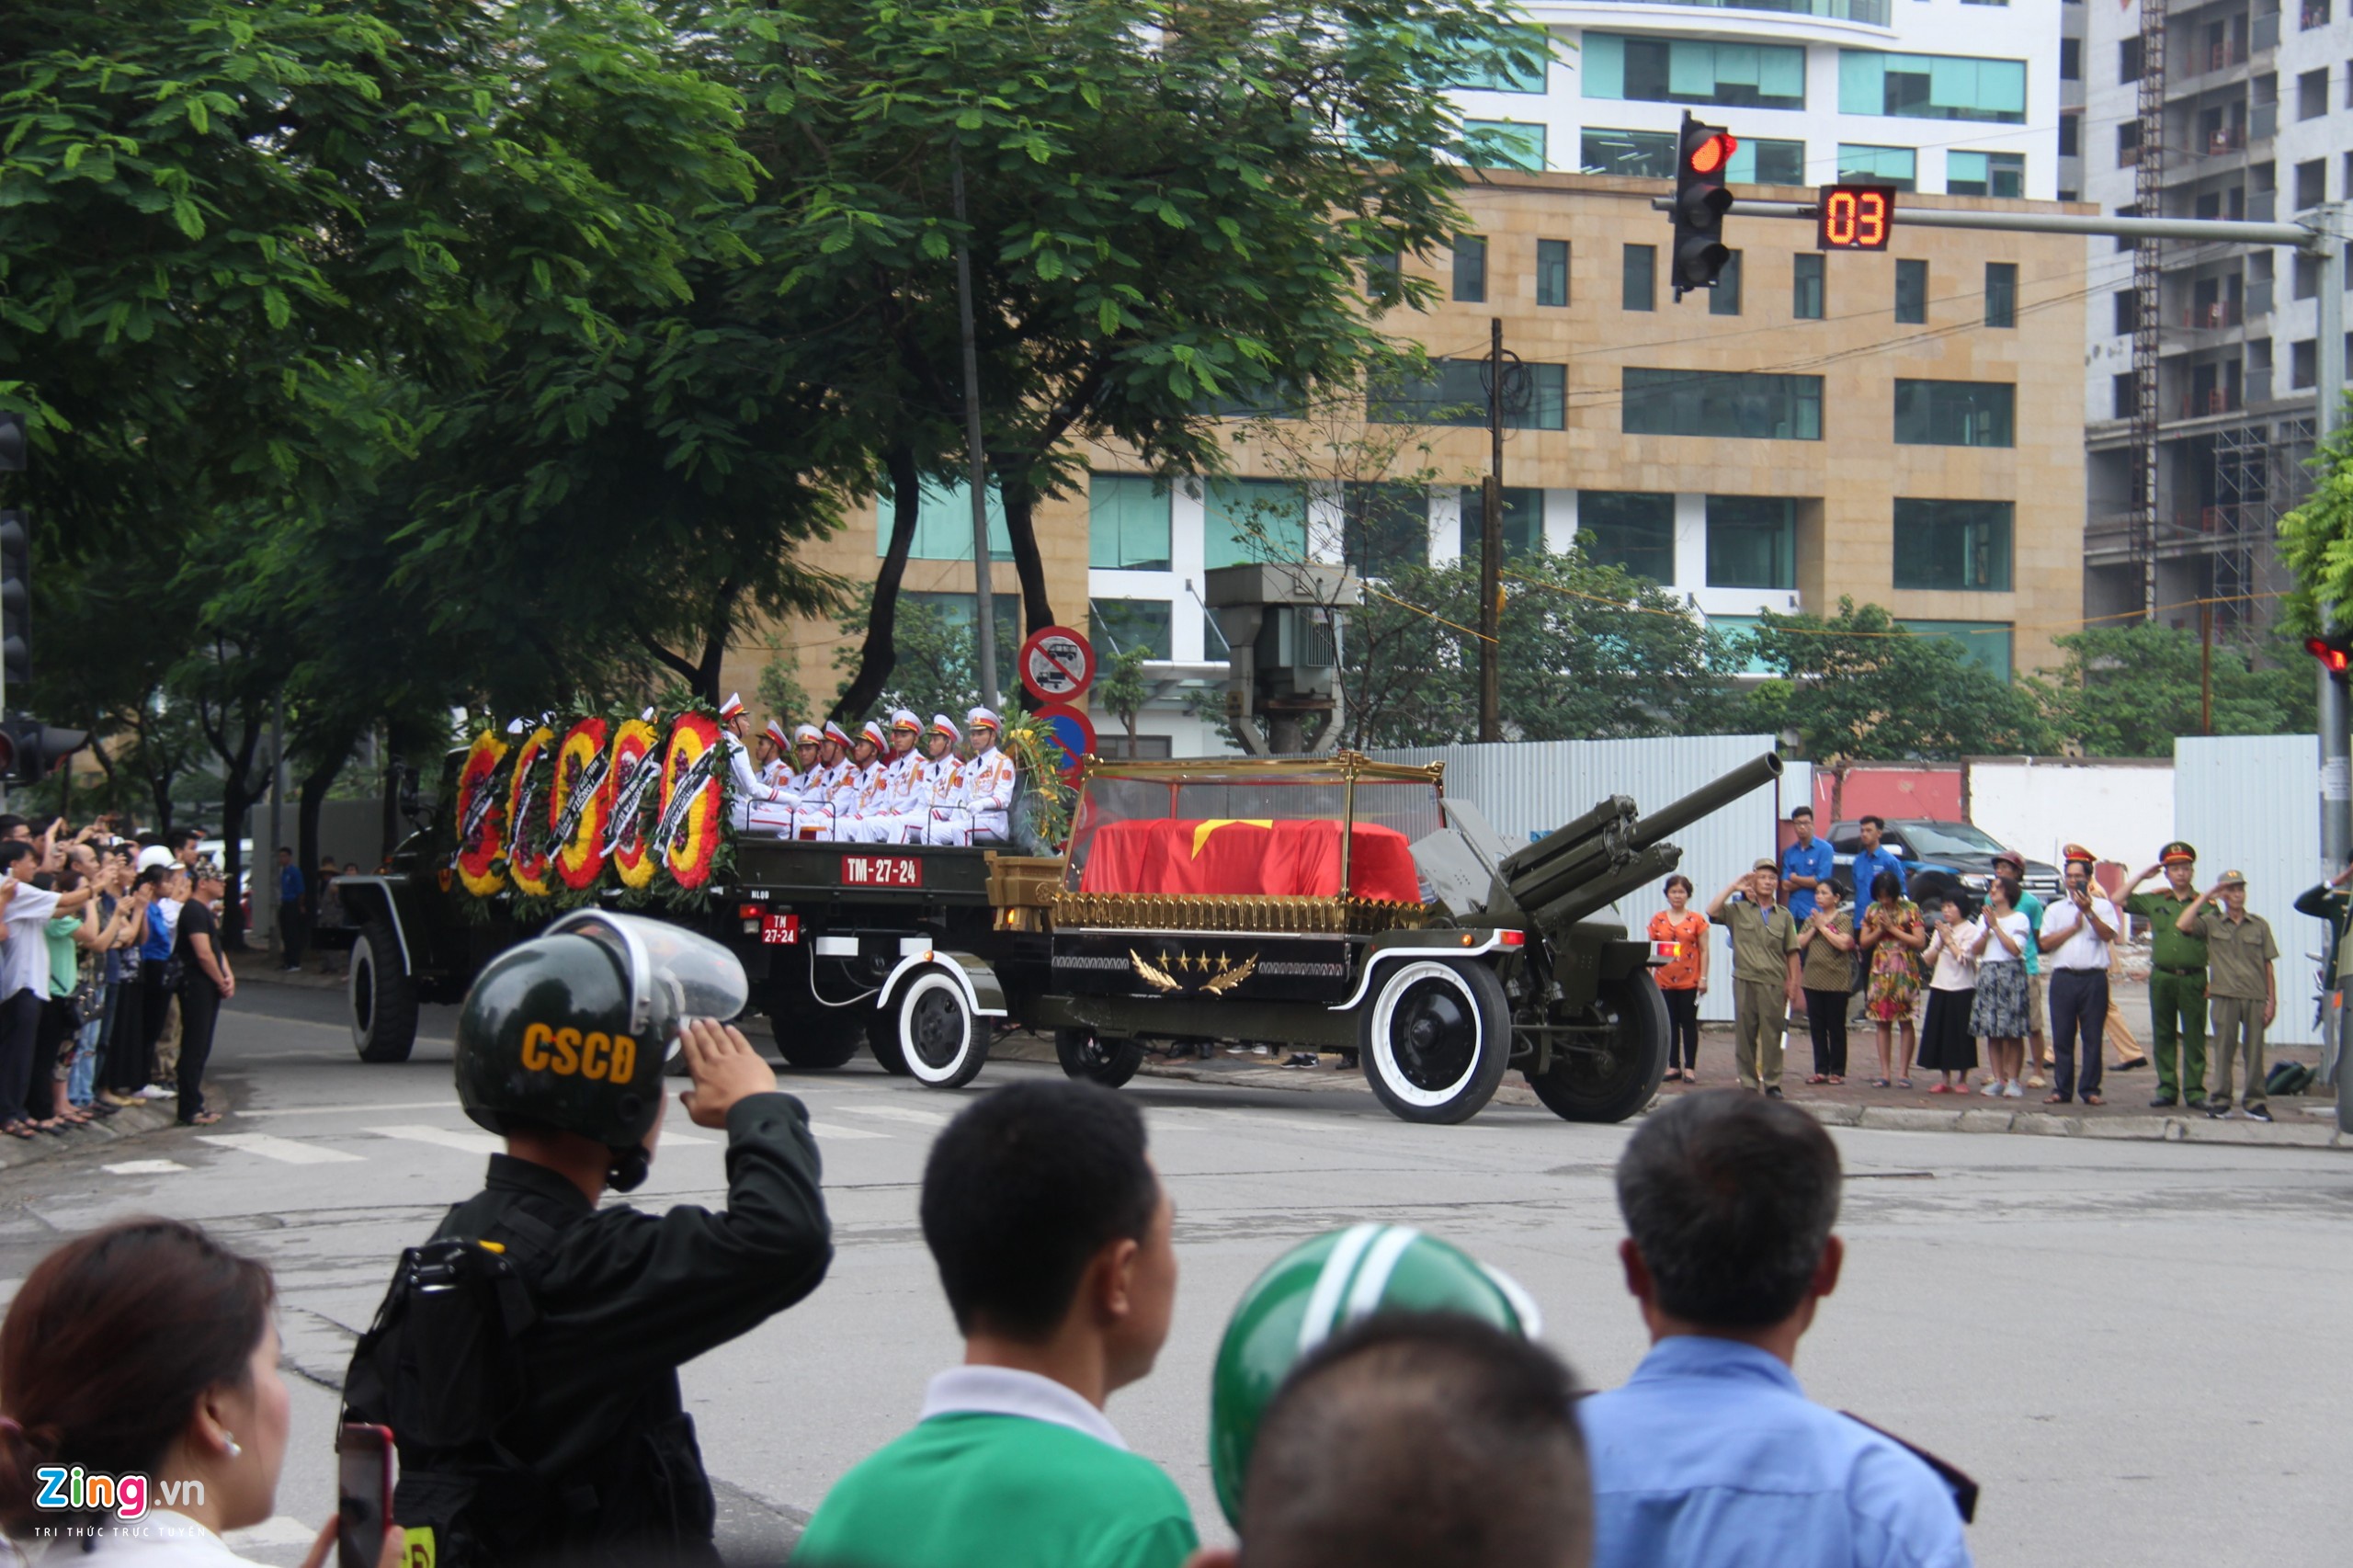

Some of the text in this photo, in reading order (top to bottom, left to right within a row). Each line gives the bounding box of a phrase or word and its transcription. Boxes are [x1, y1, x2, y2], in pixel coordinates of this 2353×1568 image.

[1827, 191, 1884, 244] 03
[847, 858, 915, 883] TM-27-24
[774, 915, 787, 928] TM
[765, 929, 794, 943] 27-24
